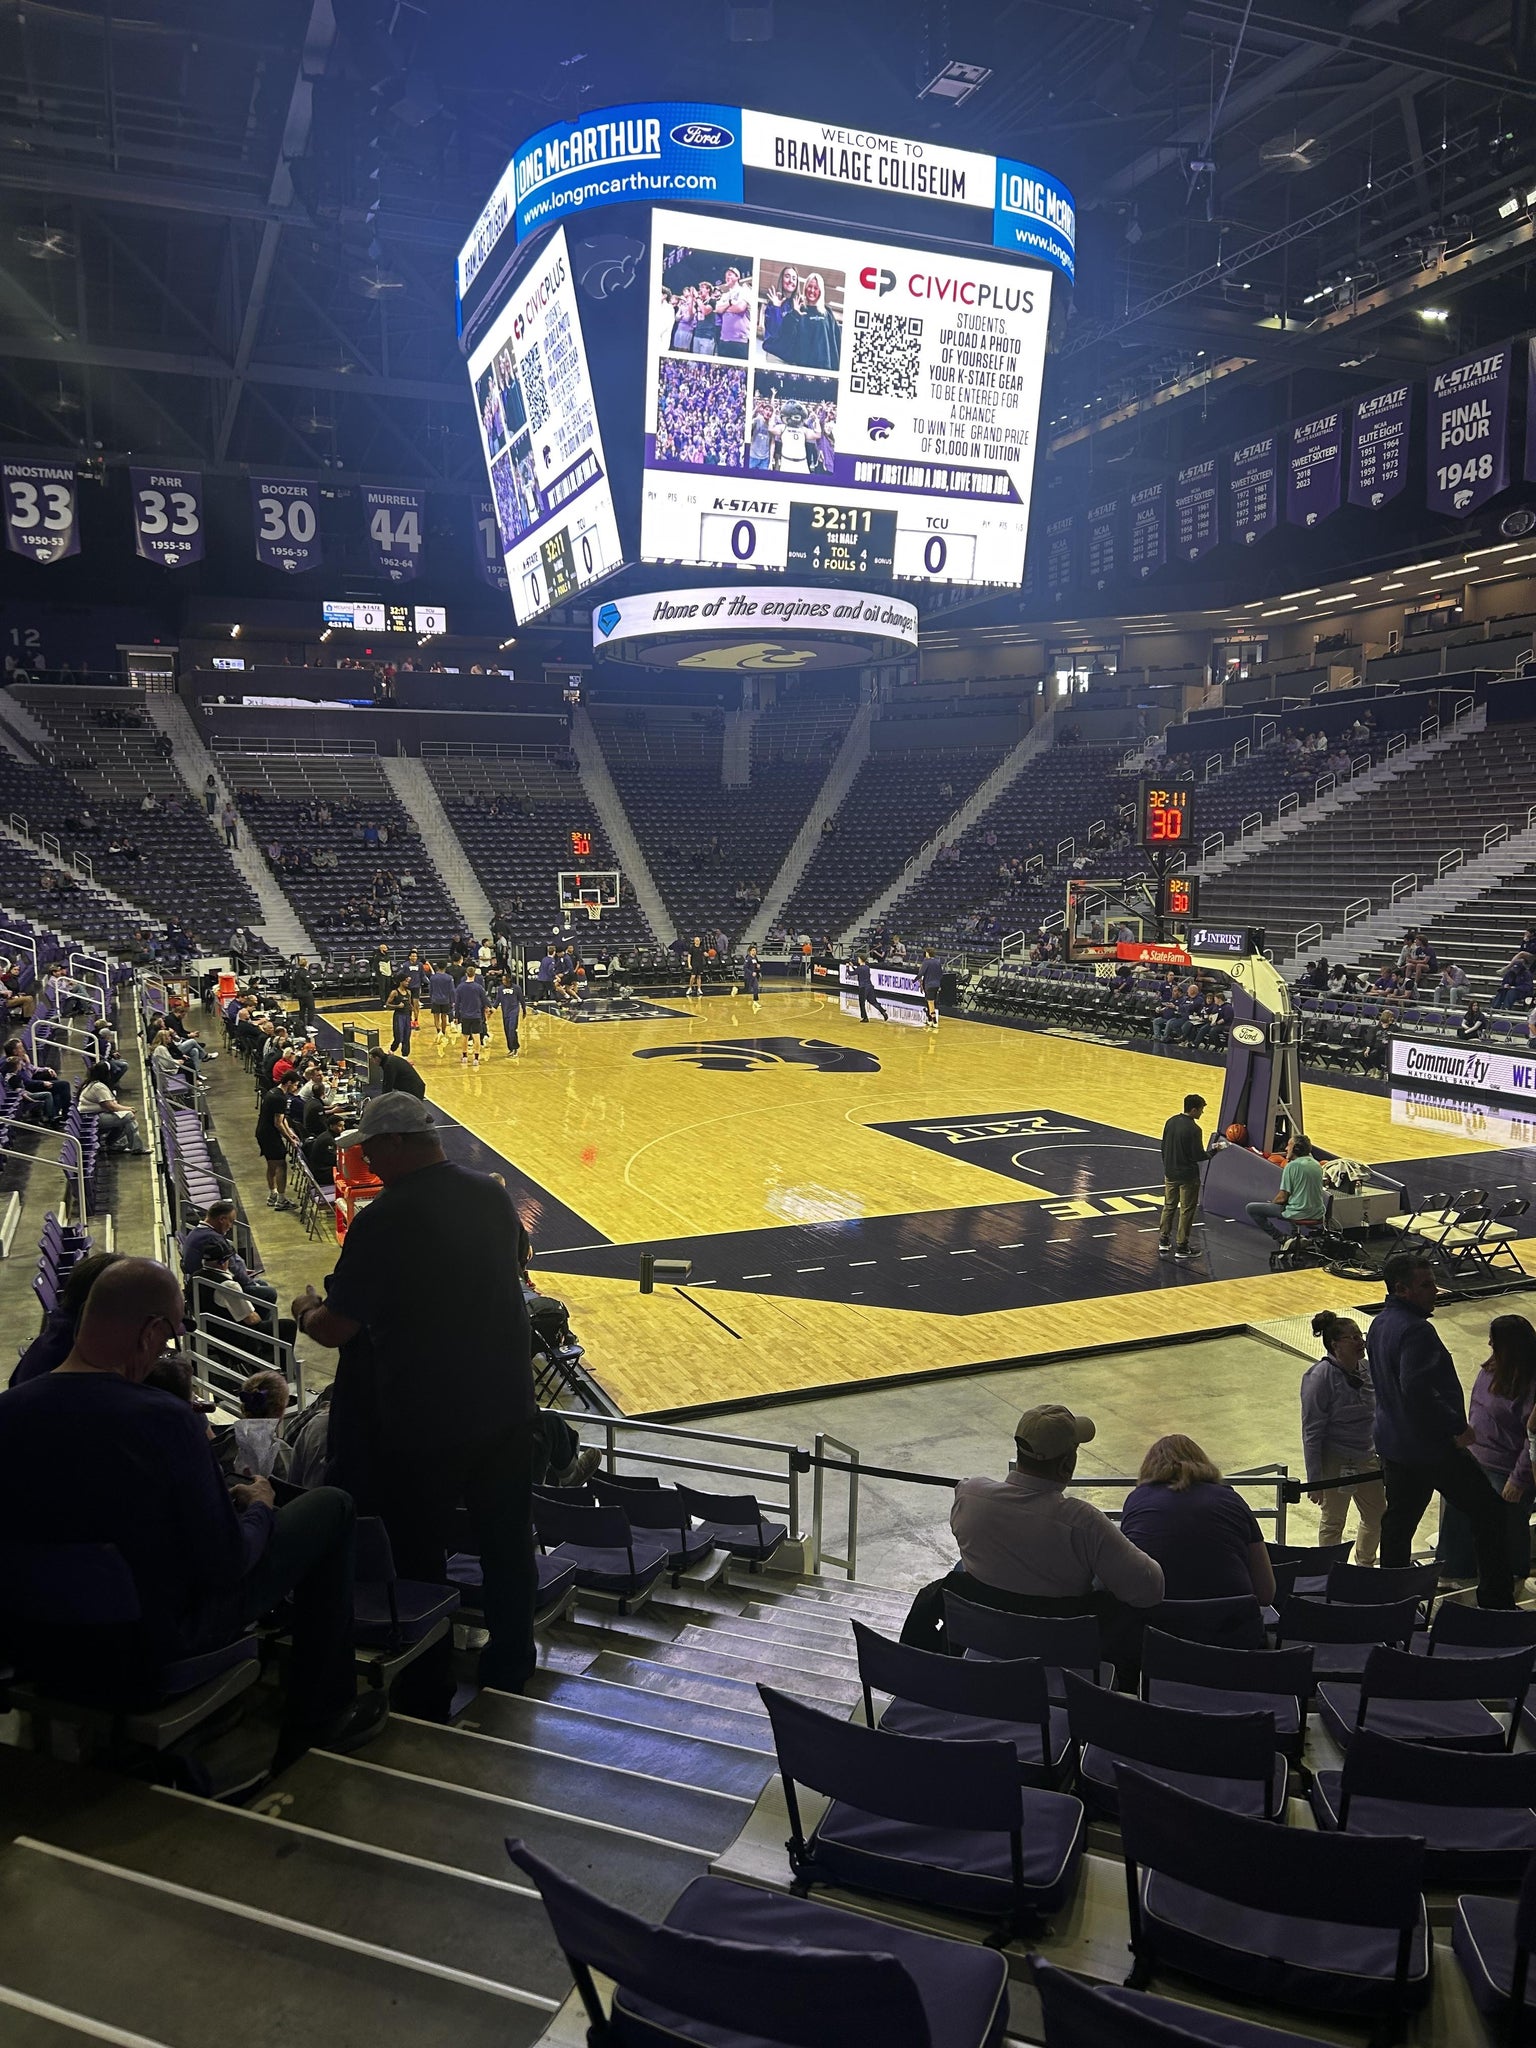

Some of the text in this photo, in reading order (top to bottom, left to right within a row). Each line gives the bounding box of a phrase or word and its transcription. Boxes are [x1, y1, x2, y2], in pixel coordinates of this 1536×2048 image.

[821, 127, 924, 158] WELCOME TO
[516, 118, 661, 197] LONG McARTHUR
[775, 137, 966, 200] BRAMLAGE COLISEUM
[524, 171, 717, 225] www.longmcarthur.com
[1001, 172, 1045, 219] LONG
[525, 257, 567, 325] CIVICPLUS
[908, 273, 1035, 314] CIVICPLUS
[940, 328, 1022, 355] UPLOAD A PHOTO
[942, 347, 1017, 373] OF YOURSELF IN
[929, 365, 1024, 391] YOUR K-STATE GEAR
[1433, 353, 1504, 393] K-STATE
[931, 383, 1019, 409] TO BE ENTERED FOR
[1438, 372, 1498, 399] MEN'S BASKETBALL
[1358, 387, 1408, 416] K-STATE
[950, 404, 996, 424] A CHANCE
[1441, 398, 1492, 431] FINAL
[913, 418, 1030, 446] TO WIN THE GRAND PRIZE
[1293, 414, 1338, 440] K-STATE
[1358, 422, 1404, 446] ELITE EIGHT
[1373, 421, 1387, 430] NCAA
[1441, 418, 1490, 450] FOUR
[921, 437, 1021, 462] OF $1,000 IN TUITION
[1233, 438, 1273, 462] K-STATE
[1291, 445, 1338, 469] SWEET SIXTEEN
[1360, 449, 1399, 468] 1958 1972
[1361, 438, 1399, 458] 1951 1964
[3, 465, 74, 481] KNOSTMAN
[1178, 460, 1215, 482] K-STATE
[1231, 468, 1274, 490] SWEET SIXTEEN
[1296, 469, 1311, 480] 2018
[1360, 459, 1398, 478] 1959 1973
[1360, 469, 1398, 488] 1961 1975
[1436, 453, 1493, 491] 1948
[150, 476, 183, 488] PARR
[261, 485, 309, 497] BOOZER
[1295, 479, 1311, 489] 2023
[368, 493, 418, 507] MURRELL
[1131, 483, 1163, 504] K-STATE
[1175, 496, 1194, 507] SWEET
[1194, 488, 1216, 501] SIXTEEN
[1236, 499, 1249, 509] 1973
[1237, 490, 1249, 499] 1972
[9, 481, 73, 531] 33
[138, 490, 200, 536] 33
[481, 502, 495, 513] KR
[713, 498, 779, 515] K-STATE
[1087, 500, 1118, 520] K-STATE
[1137, 508, 1154, 521] NCAA
[1236, 509, 1249, 518] 1975
[258, 498, 317, 543] 30
[811, 506, 872, 532] 32:11
[926, 517, 949, 530] TCU
[22, 535, 65, 546] 1950-53
[370, 508, 423, 553] 44
[478, 517, 496, 559] 1
[731, 519, 757, 560] 0
[151, 540, 192, 551] 1955-58
[270, 547, 309, 558] 1956-59
[545, 533, 565, 563] 32:11
[788, 550, 807, 559] BONUS
[813, 546, 867, 560] 4 TOL 4
[924, 535, 947, 573] 0
[379, 556, 414, 568] 1962-64
[487, 565, 506, 574] 1971
[812, 559, 867, 572] 0 FOULS 0
[364, 612, 373, 625] 0
[426, 616, 435, 628] 0
[652, 600, 698, 621] Home
[702, 597, 726, 617] of
[727, 595, 759, 617] the
[760, 598, 831, 622] engines
[832, 599, 864, 619] and
[863, 604, 880, 622] oil
[880, 609, 913, 633] changes
[9, 628, 41, 647] 12
[203, 708, 214, 716] 13
[1149, 790, 1186, 807] 32:11
[1153, 809, 1182, 839] 30
[573, 840, 590, 855] 30
[1170, 879, 1189, 893] 32:1
[1207, 933, 1242, 945] INTRUST
[1407, 1047, 1490, 1084] Community
[1408, 1070, 1475, 1087] NATIONAL BANK
